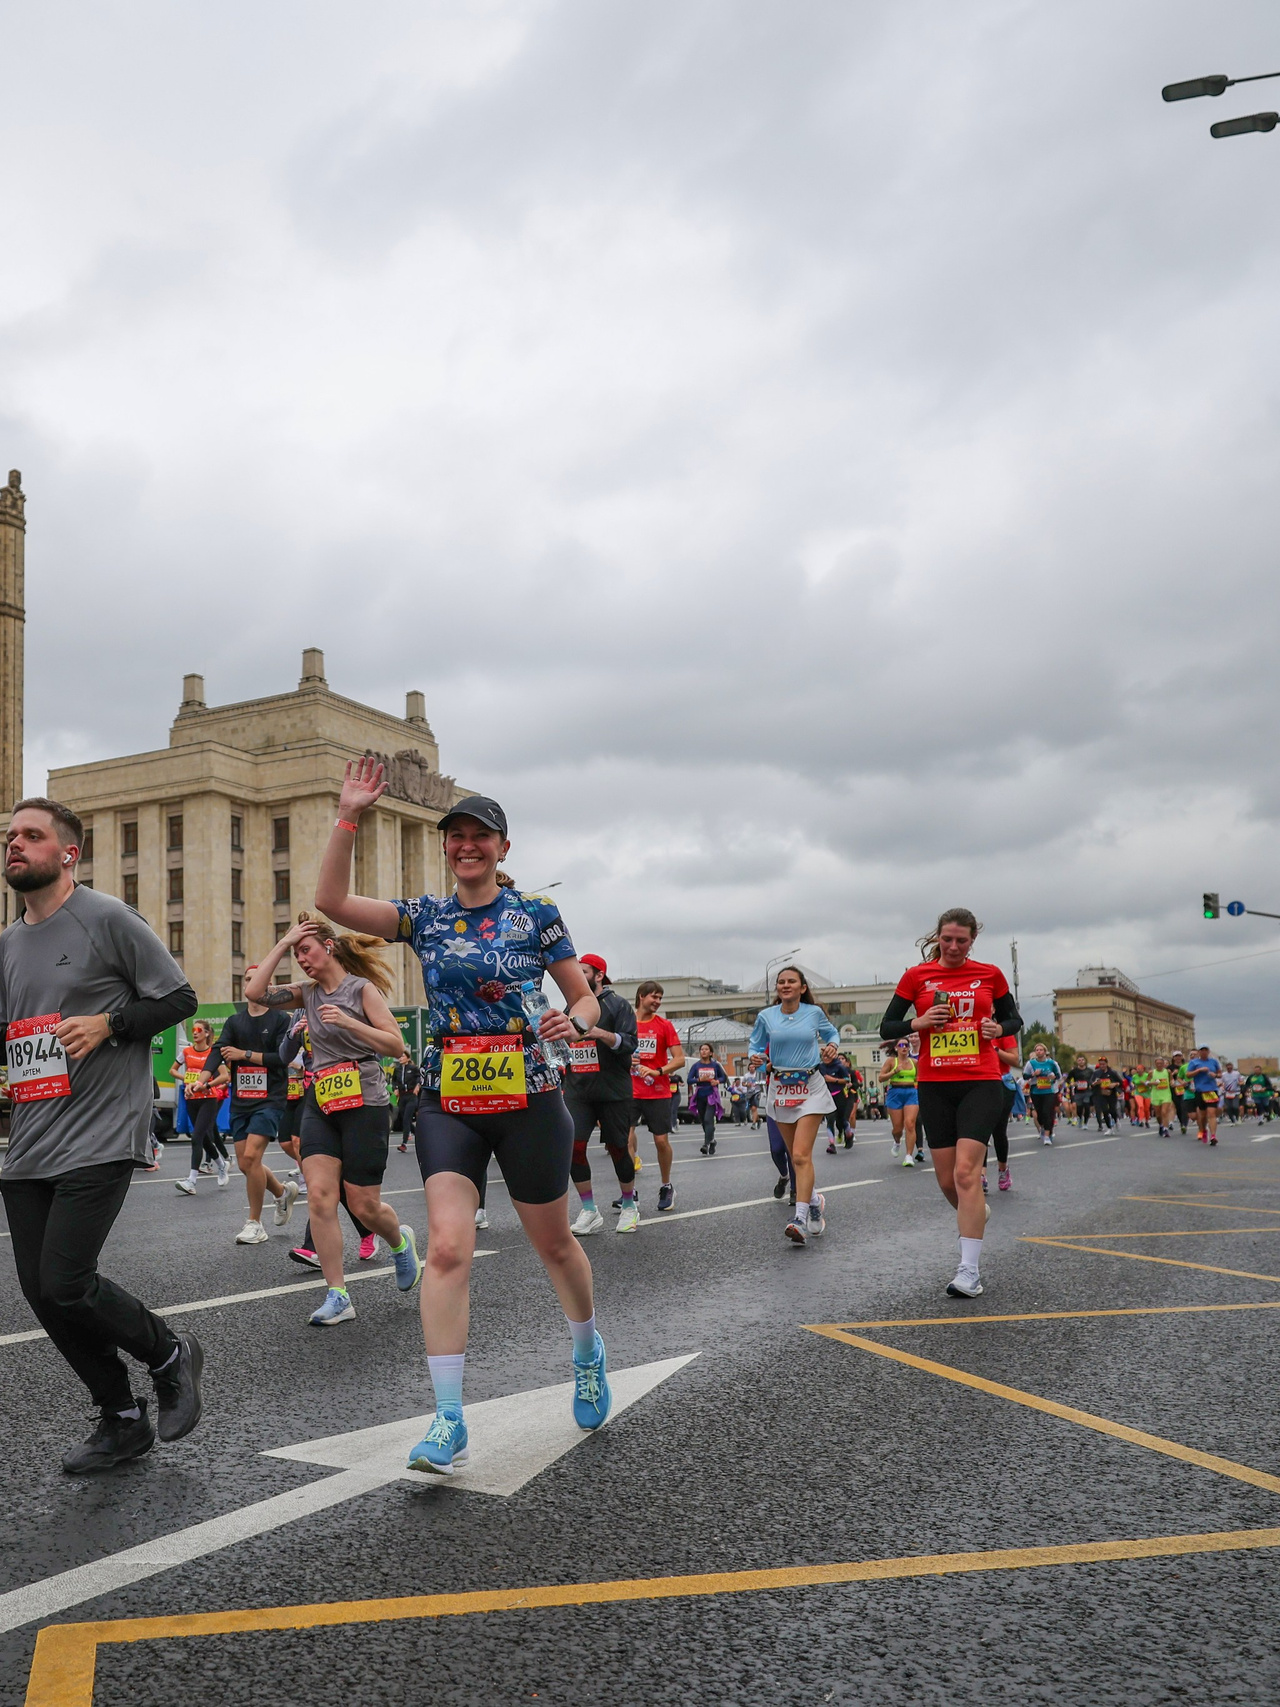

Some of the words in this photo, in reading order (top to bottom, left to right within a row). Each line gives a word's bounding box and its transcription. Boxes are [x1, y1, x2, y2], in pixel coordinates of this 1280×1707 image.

[33, 1026, 41, 1035] 10
[932, 1033, 976, 1048] 21431
[8, 1036, 63, 1069] 18944
[502, 1044, 516, 1052] KM
[934, 1057, 942, 1066] G
[22, 1068, 41, 1077] АРТЕМ
[451, 1056, 514, 1081] 2864
[240, 1075, 263, 1085] 8816
[319, 1074, 353, 1096] 3786
[13, 1087, 19, 1101] F
[776, 1084, 809, 1095] 27506
[322, 1106, 329, 1115] G
[448, 1099, 461, 1112] G
